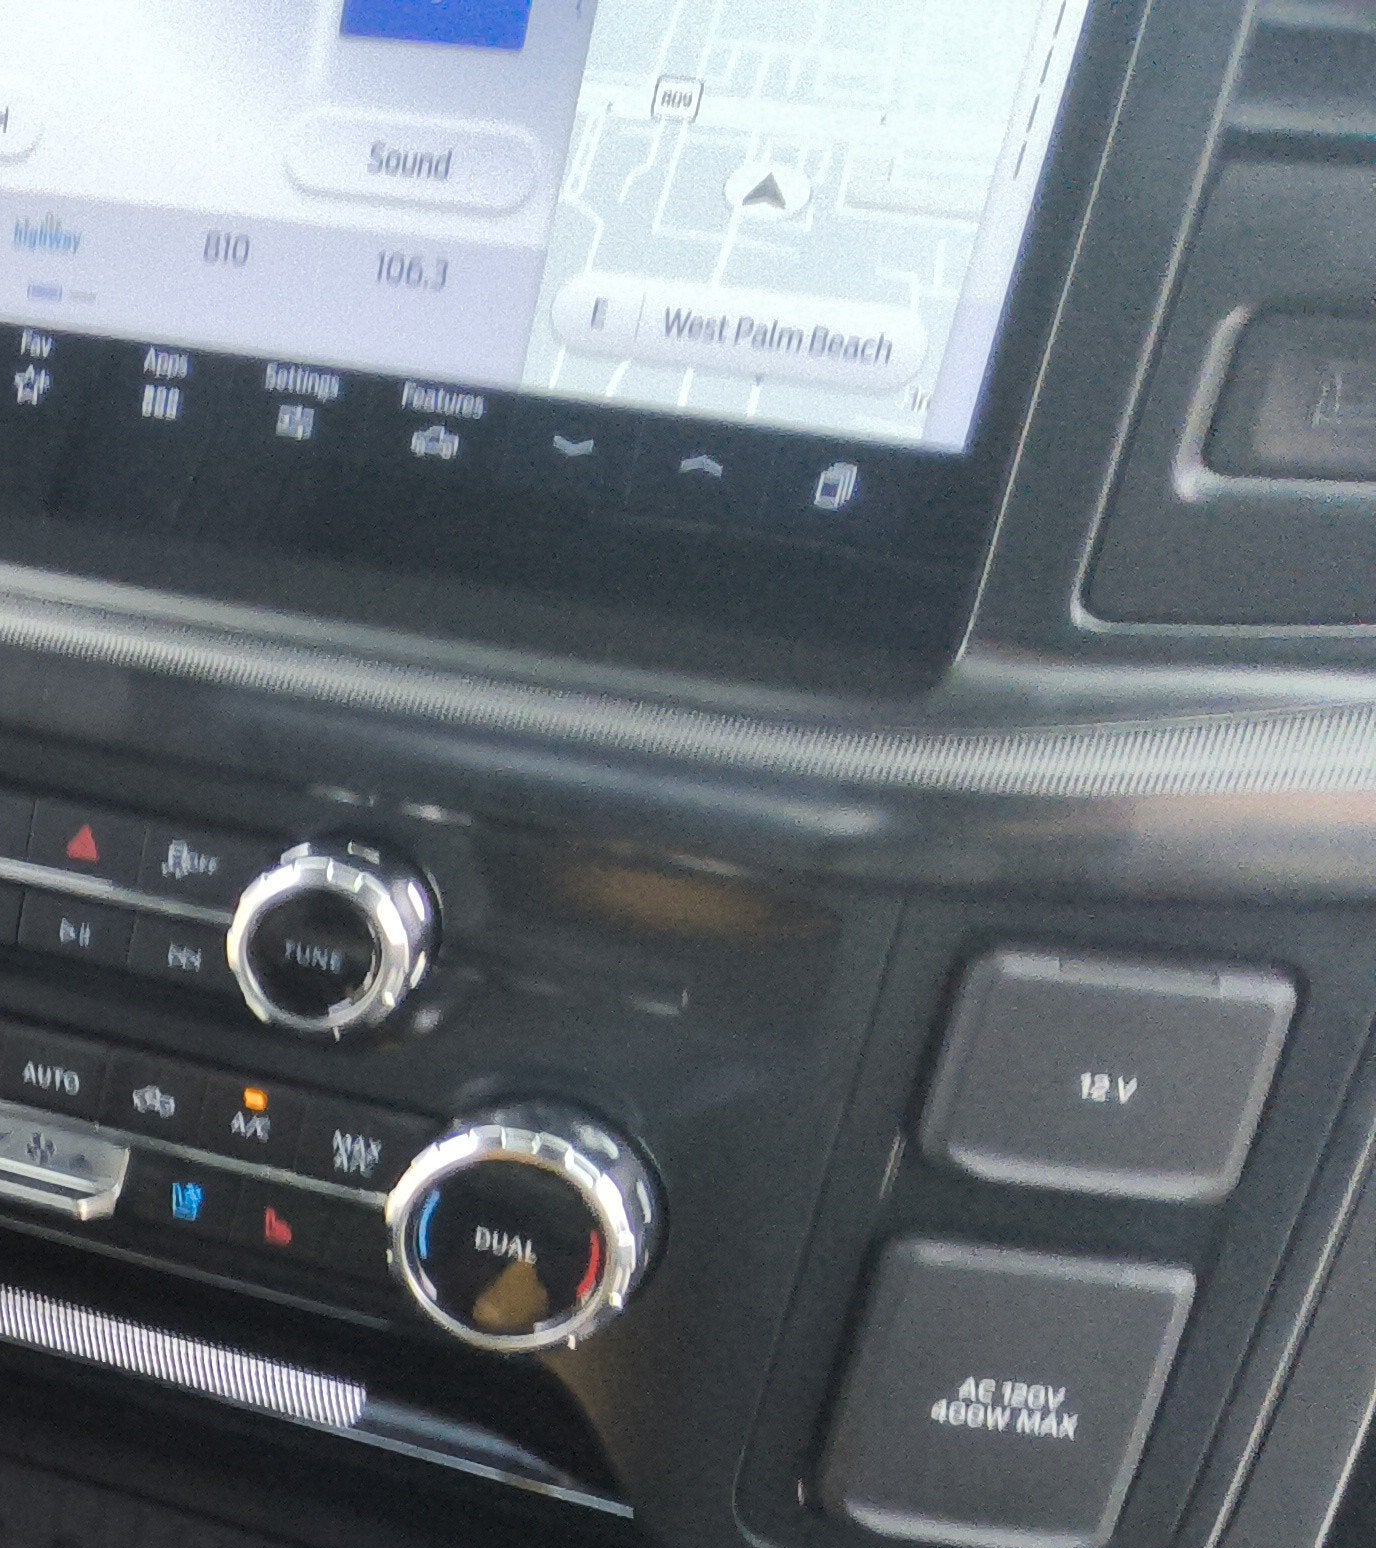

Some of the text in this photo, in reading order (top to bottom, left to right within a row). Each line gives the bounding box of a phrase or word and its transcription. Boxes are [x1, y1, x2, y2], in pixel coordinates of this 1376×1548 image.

[367, 140, 452, 181] Sound
[376, 249, 449, 291] 106.3
[20, 327, 52, 359] Fav
[663, 305, 893, 365] West Palm Beach
[143, 345, 190, 379] Apps
[265, 362, 340, 402] Settings
[402, 379, 486, 420] Features
[22, 1060, 80, 1096] AUTO
[475, 1225, 537, 1265] DUAL
[958, 1376, 996, 1405] AC
[930, 1398, 1079, 1441] 400W MAX
